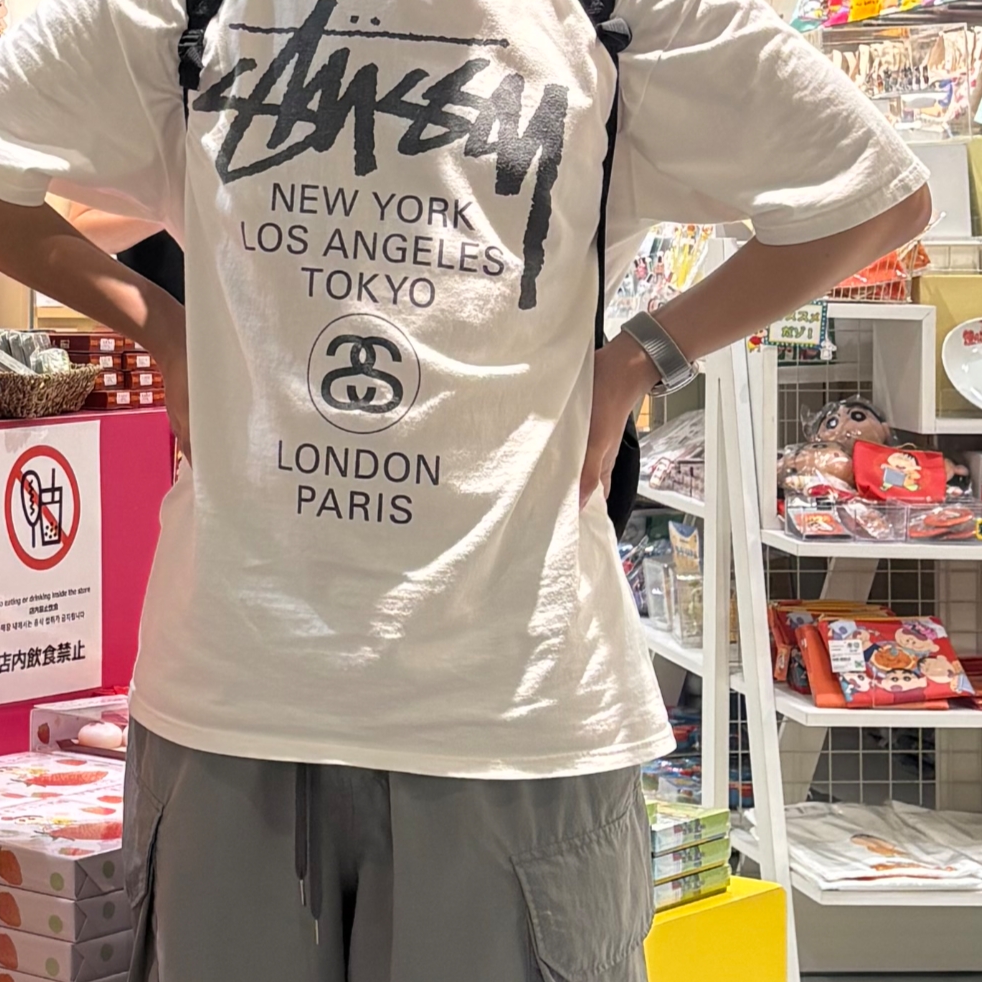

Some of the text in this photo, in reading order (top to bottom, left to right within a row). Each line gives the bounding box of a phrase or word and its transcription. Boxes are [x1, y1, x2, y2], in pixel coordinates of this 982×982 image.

[271, 183, 475, 230] NEW YORK
[240, 222, 505, 277] LOS ANGELES
[301, 267, 436, 308] TOKYO
[278, 440, 440, 486] LONDON
[297, 485, 413, 524] PARIS
[4, 597, 21, 607] eating
[29, 592, 50, 602] drinking
[52, 590, 67, 599] inside
[68, 588, 76, 596] the
[78, 586, 90, 595] store
